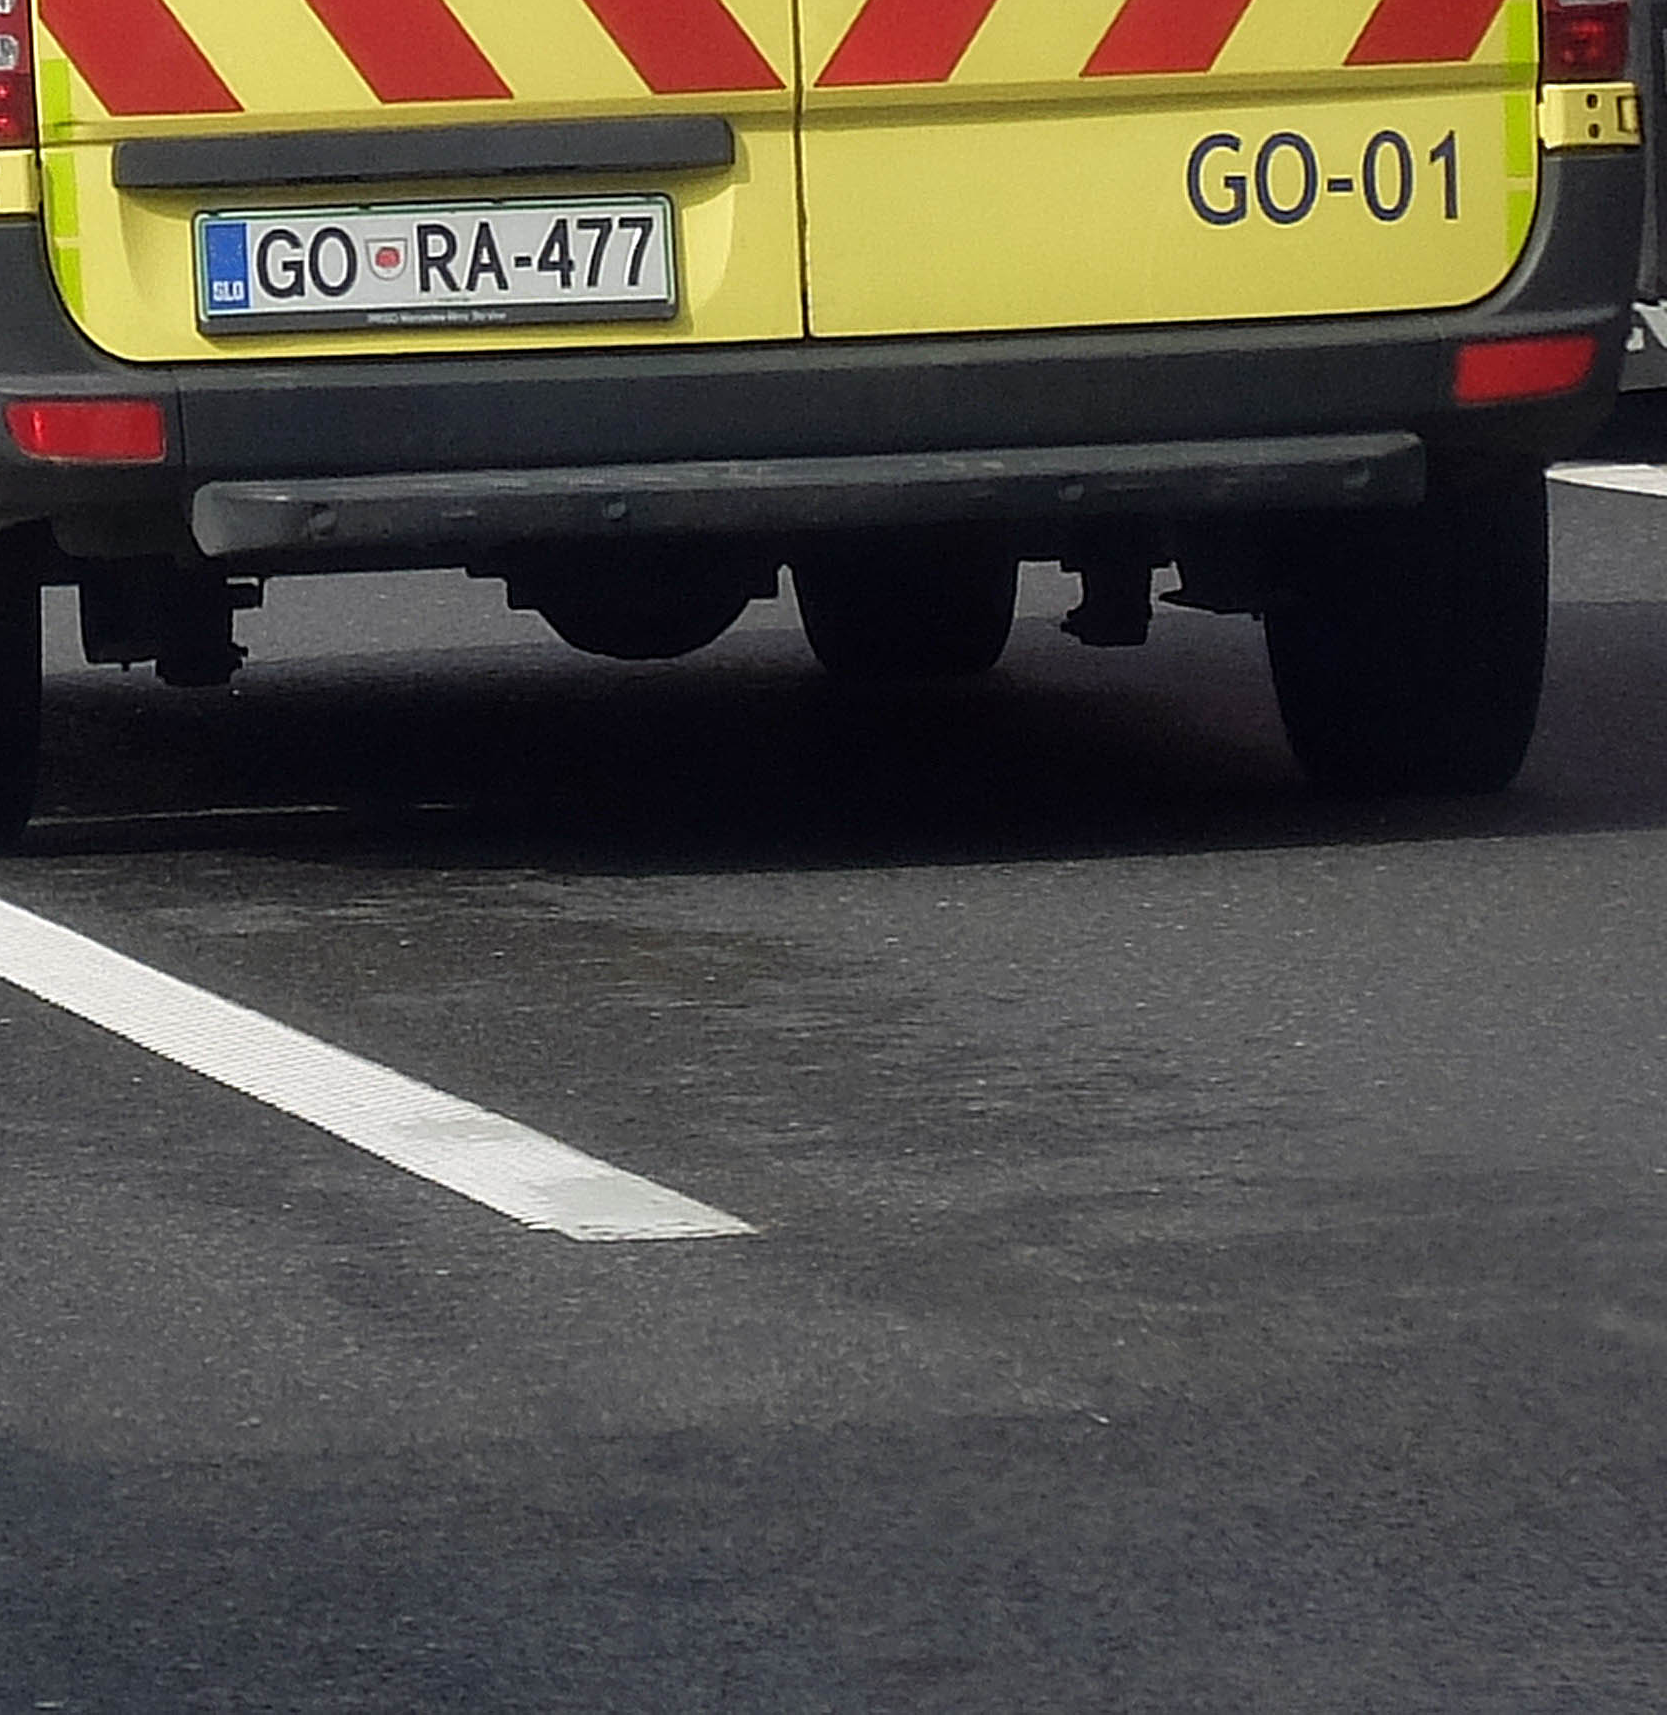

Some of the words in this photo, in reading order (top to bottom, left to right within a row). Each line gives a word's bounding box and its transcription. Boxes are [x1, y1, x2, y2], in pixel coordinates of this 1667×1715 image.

[1186, 129, 1460, 226] GO-01
[213, 280, 244, 301] SLO
[255, 227, 358, 299] GO
[416, 217, 654, 294] RA-477
